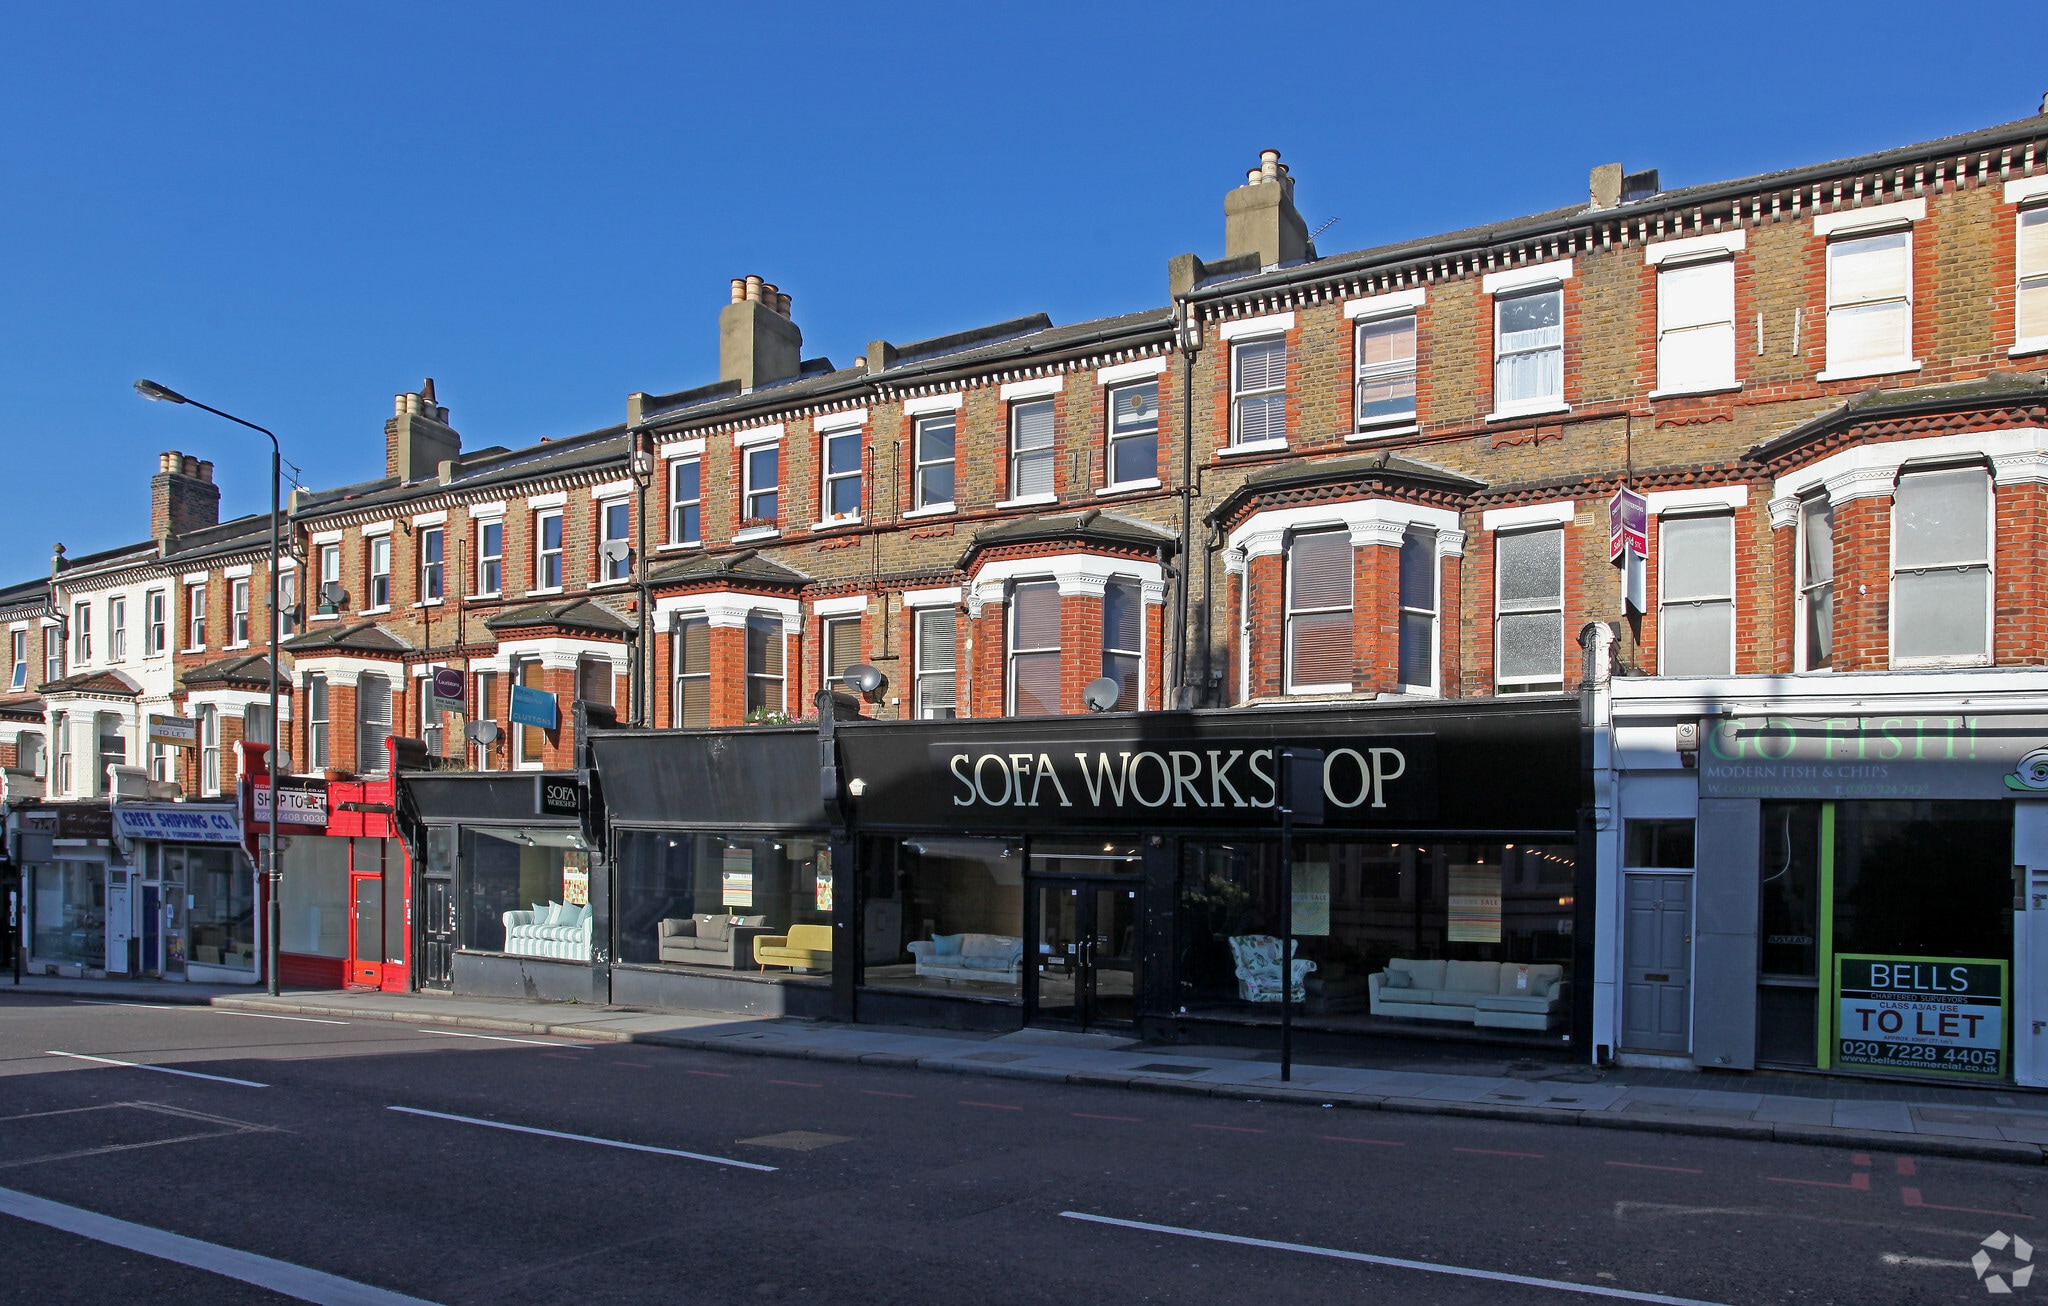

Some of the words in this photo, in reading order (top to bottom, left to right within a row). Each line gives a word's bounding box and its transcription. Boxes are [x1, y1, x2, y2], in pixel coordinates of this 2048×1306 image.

[438, 679, 460, 687] Lauristons
[513, 712, 551, 726] CLUTTONS
[1709, 718, 1797, 761] GO
[1824, 717, 1976, 760] FISH!
[949, 752, 1073, 807] SOFA
[1074, 748, 1406, 808] WORKSOP
[1707, 766, 1776, 778] MODERN
[1782, 766, 1817, 778] FISH
[1822, 766, 1834, 778] &
[1838, 766, 1888, 778] CHIPS
[547, 785, 576, 802] SOFA
[1846, 785, 1872, 794] 0207
[1877, 785, 1896, 794] 924
[258, 792, 286, 808] SHP
[290, 794, 304, 808] TO
[548, 799, 576, 808] WORKSHOP
[122, 812, 156, 827] CRETE
[156, 813, 208, 829] SHIPPING
[211, 814, 232, 830] CO.
[303, 814, 326, 822] 0030
[1870, 964, 1968, 992] BELLS
[1870, 992, 1918, 1001] CHARTERED
[1920, 994, 1968, 1004] SURVEYORS
[1880, 1002, 1910, 1010] CLASS
[1912, 1004, 1938, 1012] A3/A5
[1855, 1008, 1903, 1034] TO
[1916, 1012, 1984, 1038] LET
[1842, 1041, 1879, 1056] 020
[1886, 1044, 1936, 1061] 7228
[1944, 1048, 1996, 1065] 4405
[1841, 1054, 1997, 1074] www.bellscommercial.co.uk
